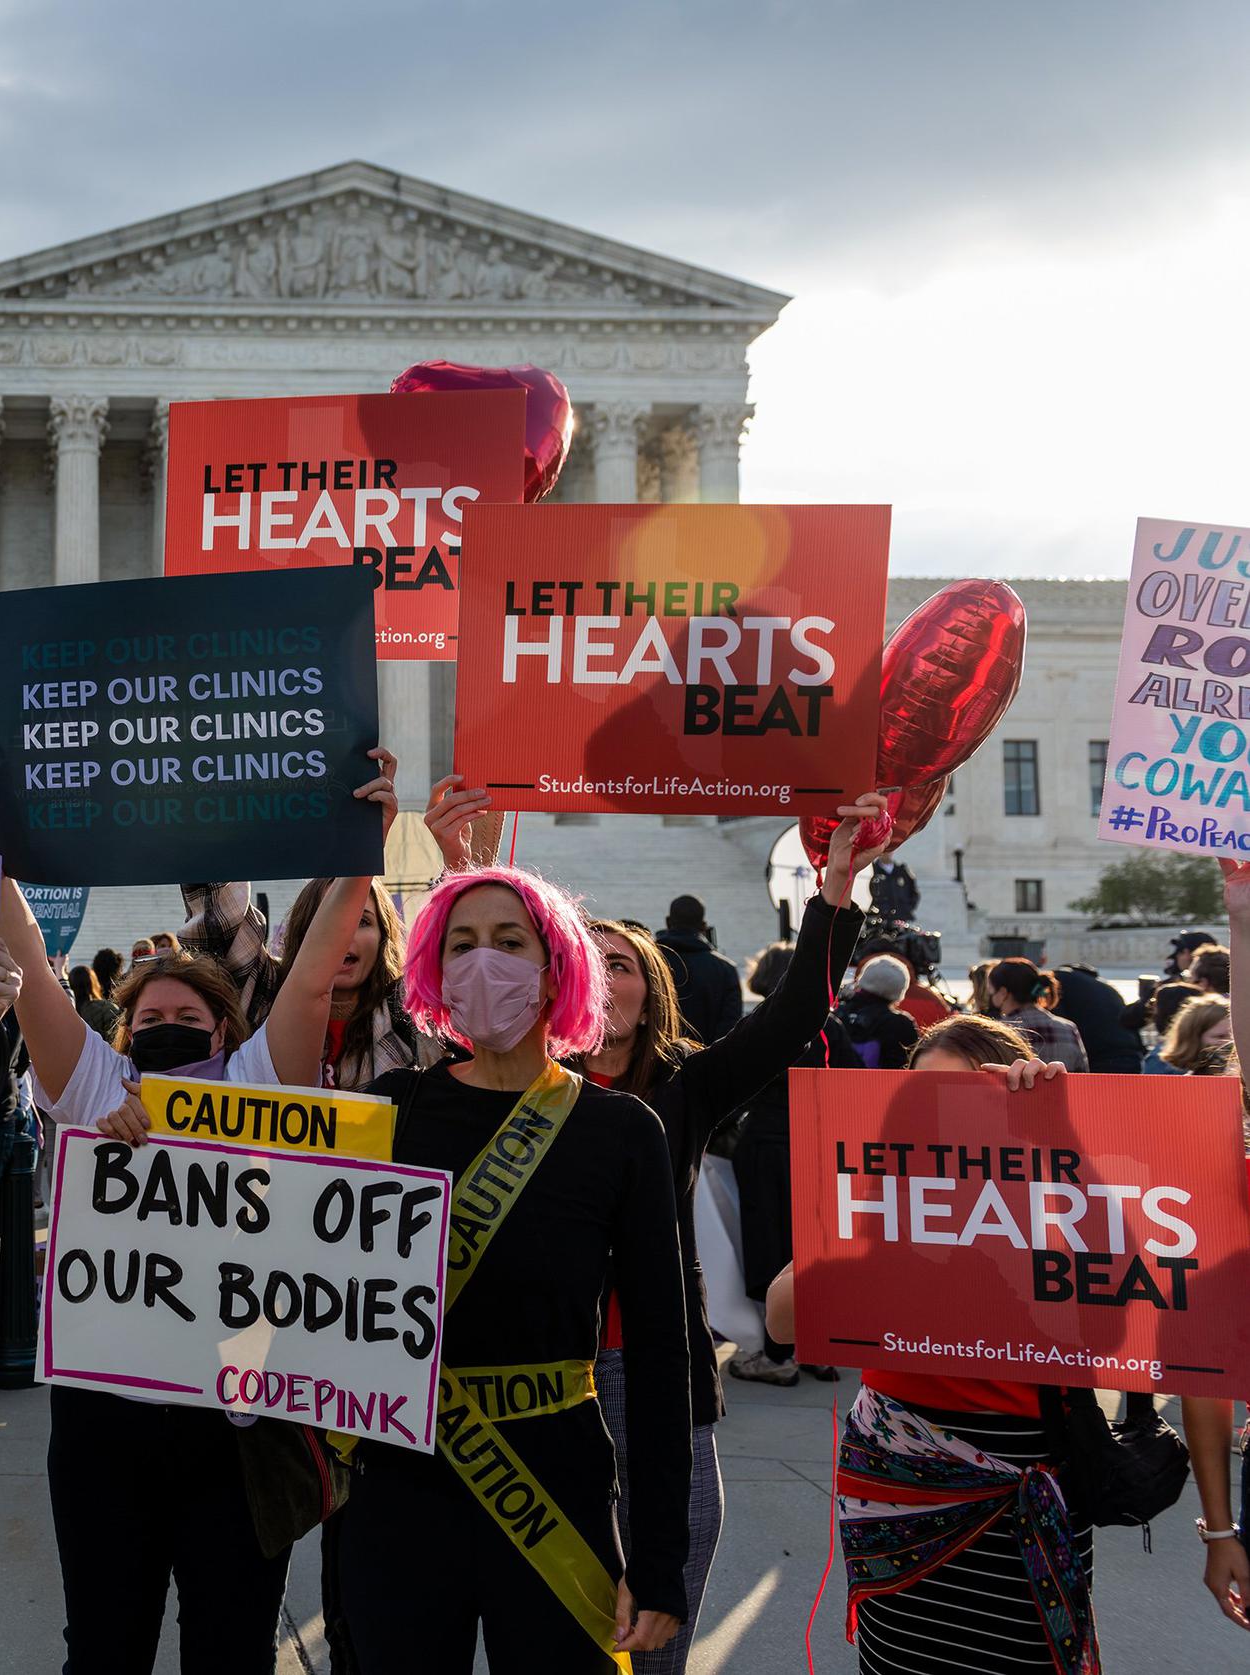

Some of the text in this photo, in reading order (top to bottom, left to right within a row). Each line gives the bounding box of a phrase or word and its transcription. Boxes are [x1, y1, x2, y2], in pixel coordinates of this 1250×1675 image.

[204, 459, 398, 493] LET THEIR
[202, 485, 480, 550] HEARTS
[505, 581, 740, 617] LET THEIR
[1136, 570, 1250, 629] OVE
[21, 626, 321, 672] KEEP OUR CLINICS
[502, 615, 836, 687] HEARTS
[22, 666, 324, 710] KEEP OUR CLINICS
[683, 684, 833, 737] BEAT
[22, 708, 326, 751] KEEP OUR CLINICS
[1170, 713, 1250, 763] YO
[24, 760, 101, 790] KEEP
[110, 757, 183, 787] OUR
[192, 750, 328, 783] CLINICS
[538, 774, 791, 804] StudentsforLifeAction.org
[27, 792, 331, 831] KEEP OUR CLINICS
[73, 887, 83, 900] IS
[165, 1089, 338, 1149] CAUTION
[447, 1104, 555, 1270] CAUTION
[836, 1141, 1082, 1184] LET THEIR
[92, 1142, 442, 1259] BANS OFF
[837, 1172, 1198, 1259] HEARTS
[57, 1248, 196, 1323] OUR
[217, 1261, 437, 1360] BODIES
[1032, 1249, 1199, 1311] BEAT
[883, 1332, 1164, 1380] StudentsforLifeAction.org
[215, 1365, 417, 1444] CODEPINK
[459, 1371, 564, 1419] TION
